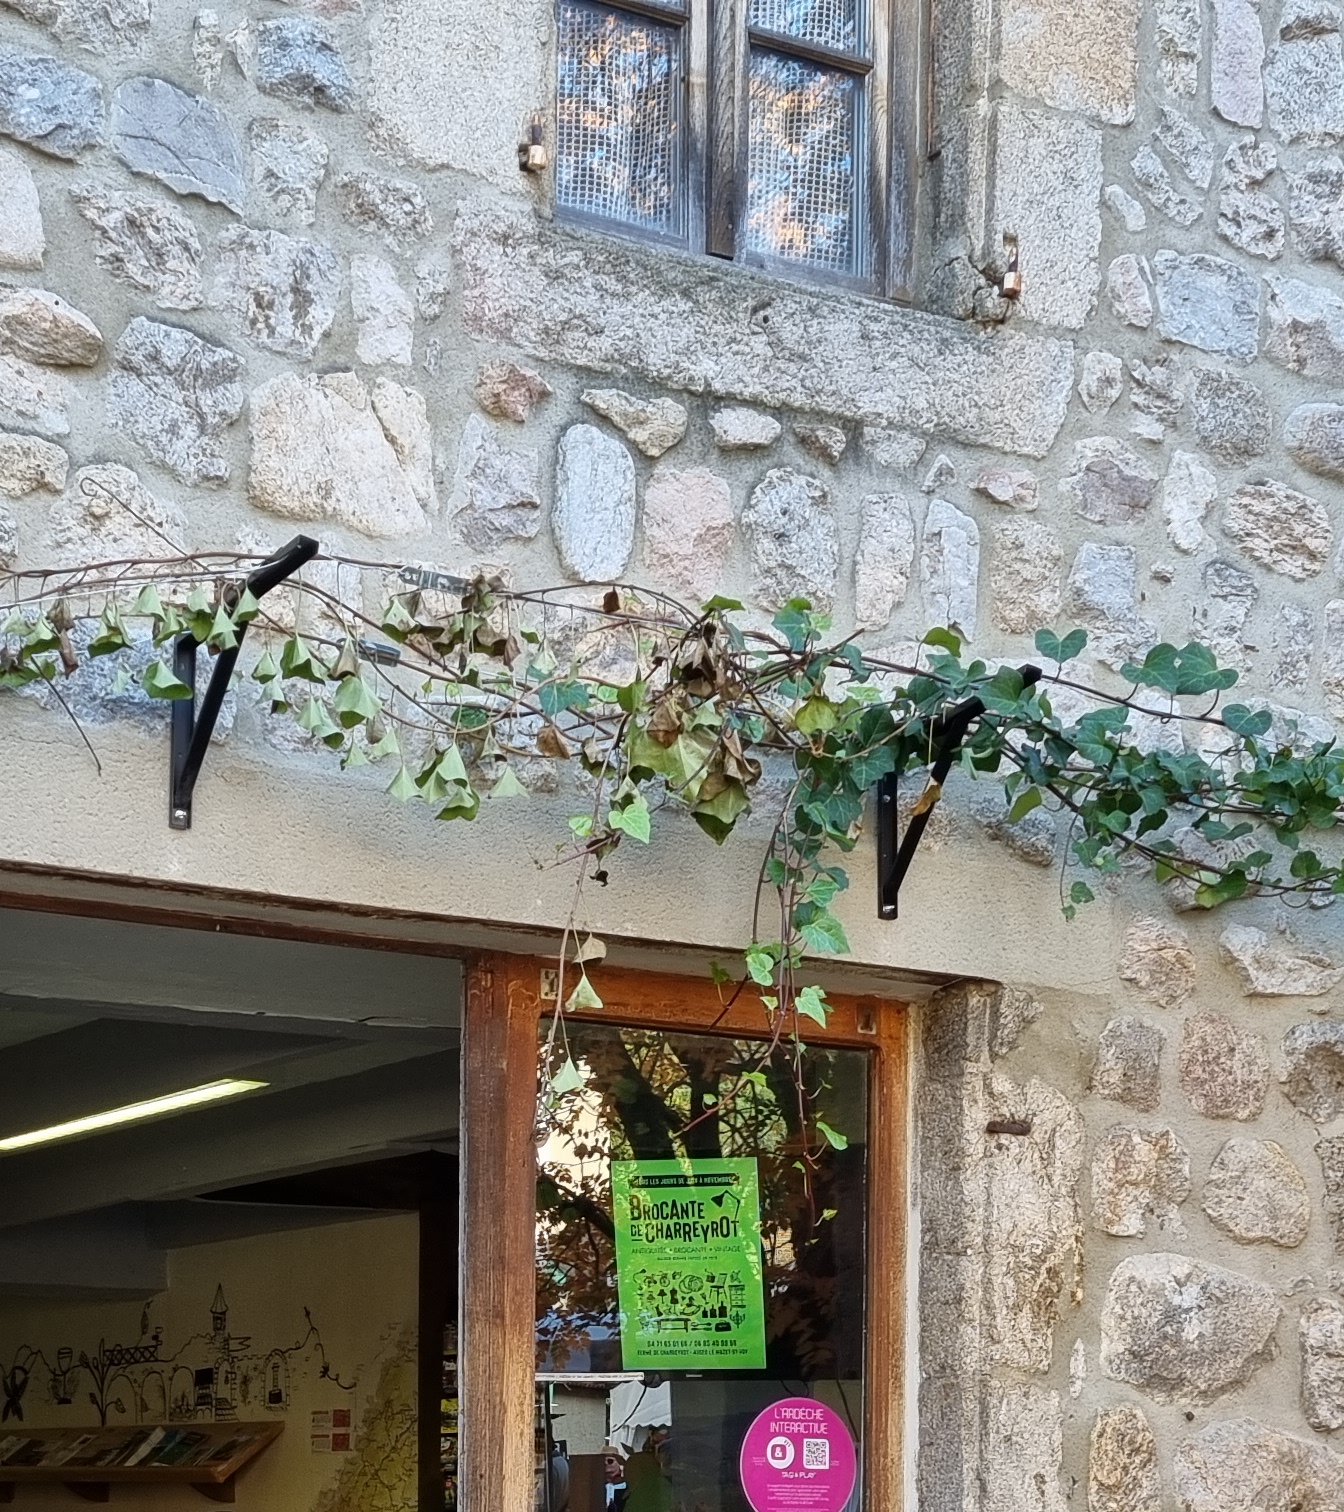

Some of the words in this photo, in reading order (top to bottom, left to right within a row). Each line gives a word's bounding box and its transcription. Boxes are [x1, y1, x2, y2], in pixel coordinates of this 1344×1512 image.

[629, 1194, 705, 1221] BROCANTE
[630, 1223, 643, 1237] DE
[645, 1216, 739, 1243] CHARREYROT
[770, 1422, 828, 1435] INTERACTIVE
